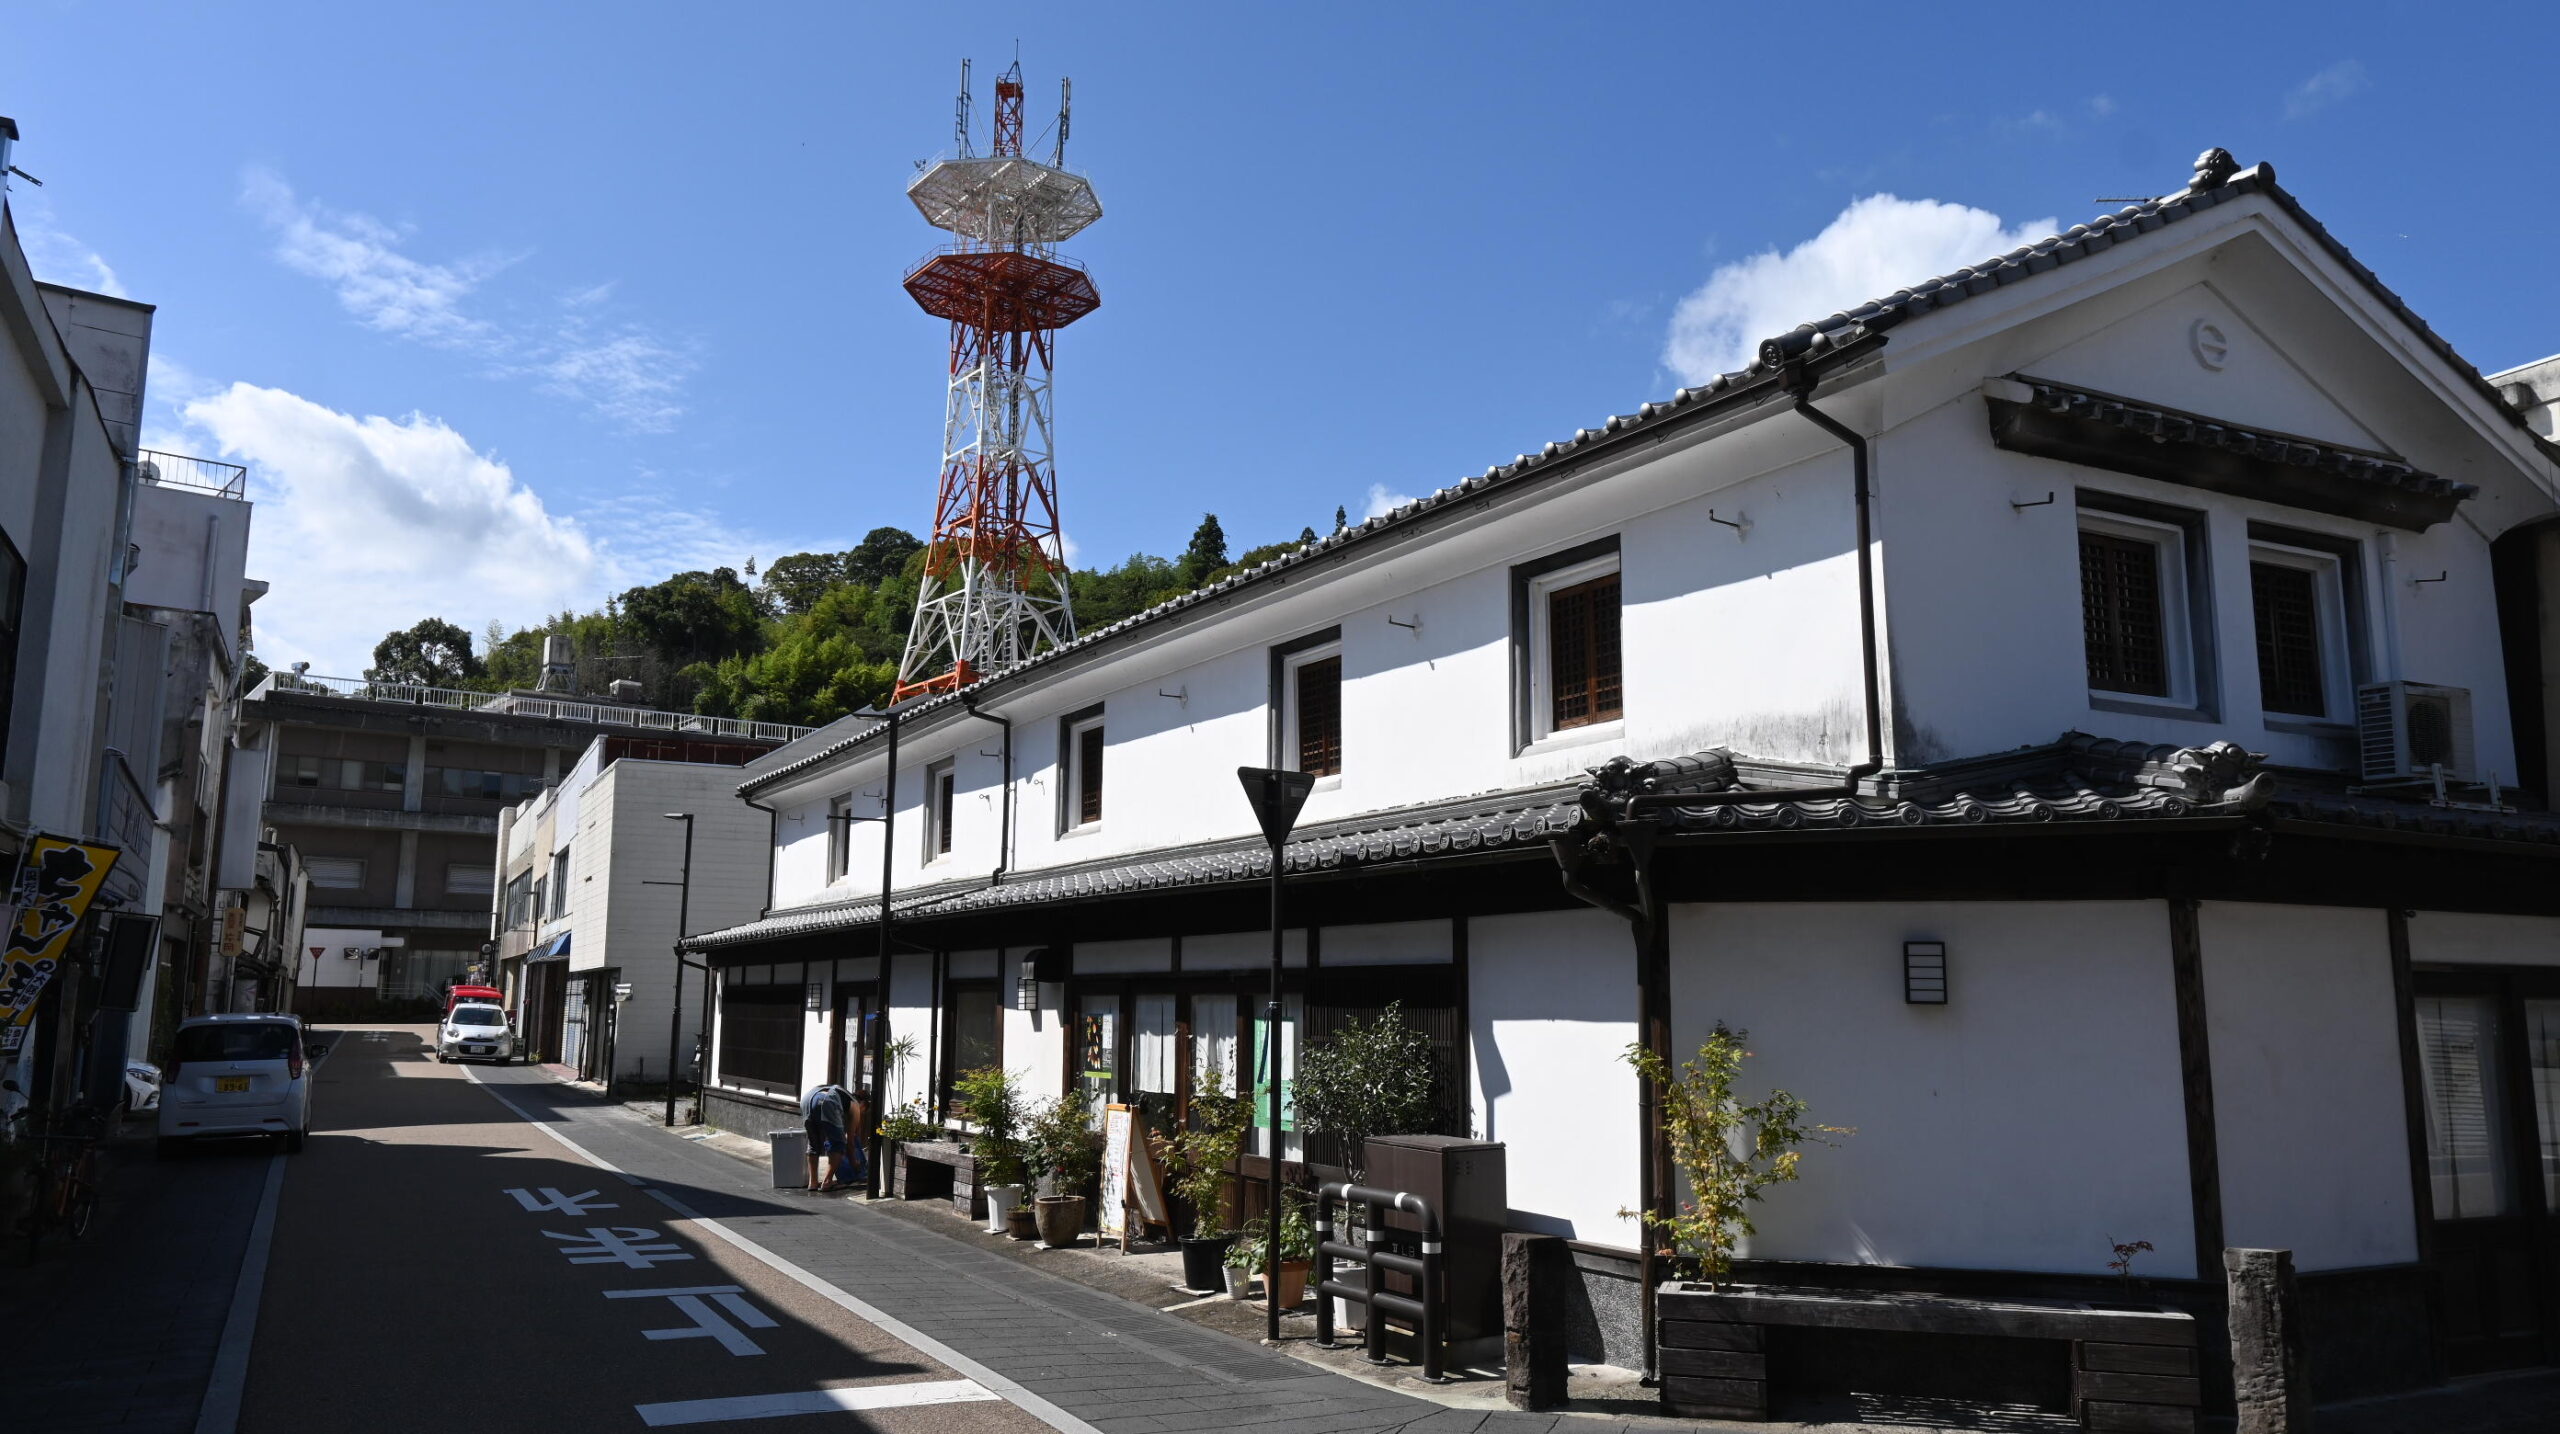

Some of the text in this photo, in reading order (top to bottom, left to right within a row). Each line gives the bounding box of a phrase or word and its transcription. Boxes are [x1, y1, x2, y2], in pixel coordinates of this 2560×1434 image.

[0, 845, 95, 1022] ちゃんぽ
[502, 1187, 781, 1357] 止まれ
